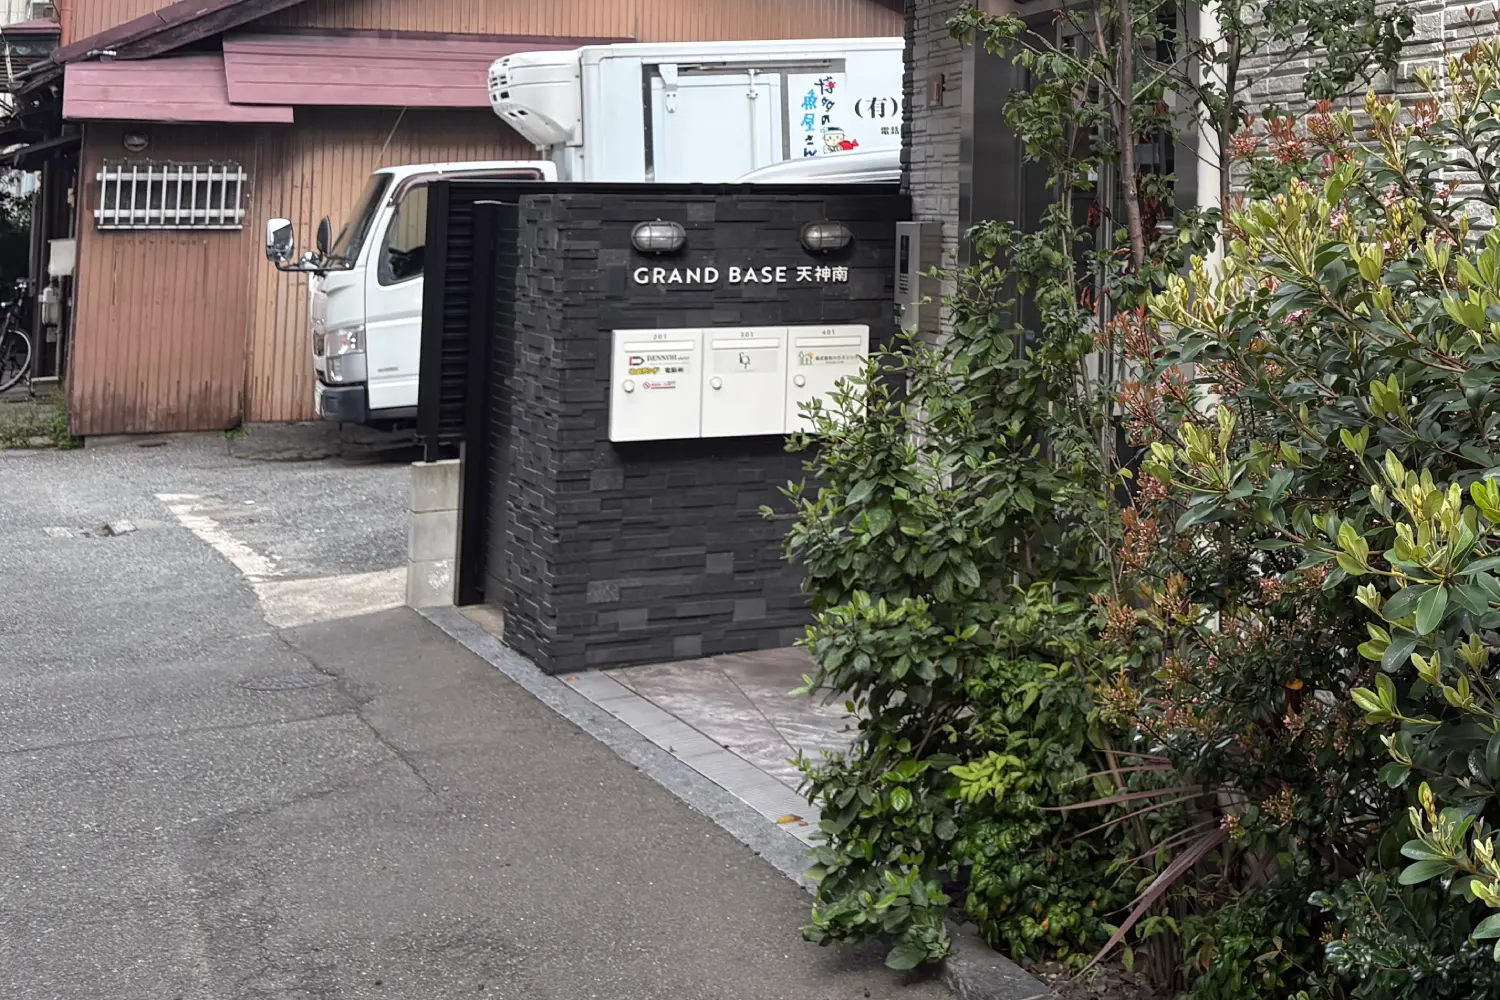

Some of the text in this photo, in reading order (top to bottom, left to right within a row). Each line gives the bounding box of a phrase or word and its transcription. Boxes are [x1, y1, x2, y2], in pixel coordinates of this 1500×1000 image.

[801, 88, 817, 157] 魚屋さん
[633, 265, 849, 285] GRAND BASE 天神南
